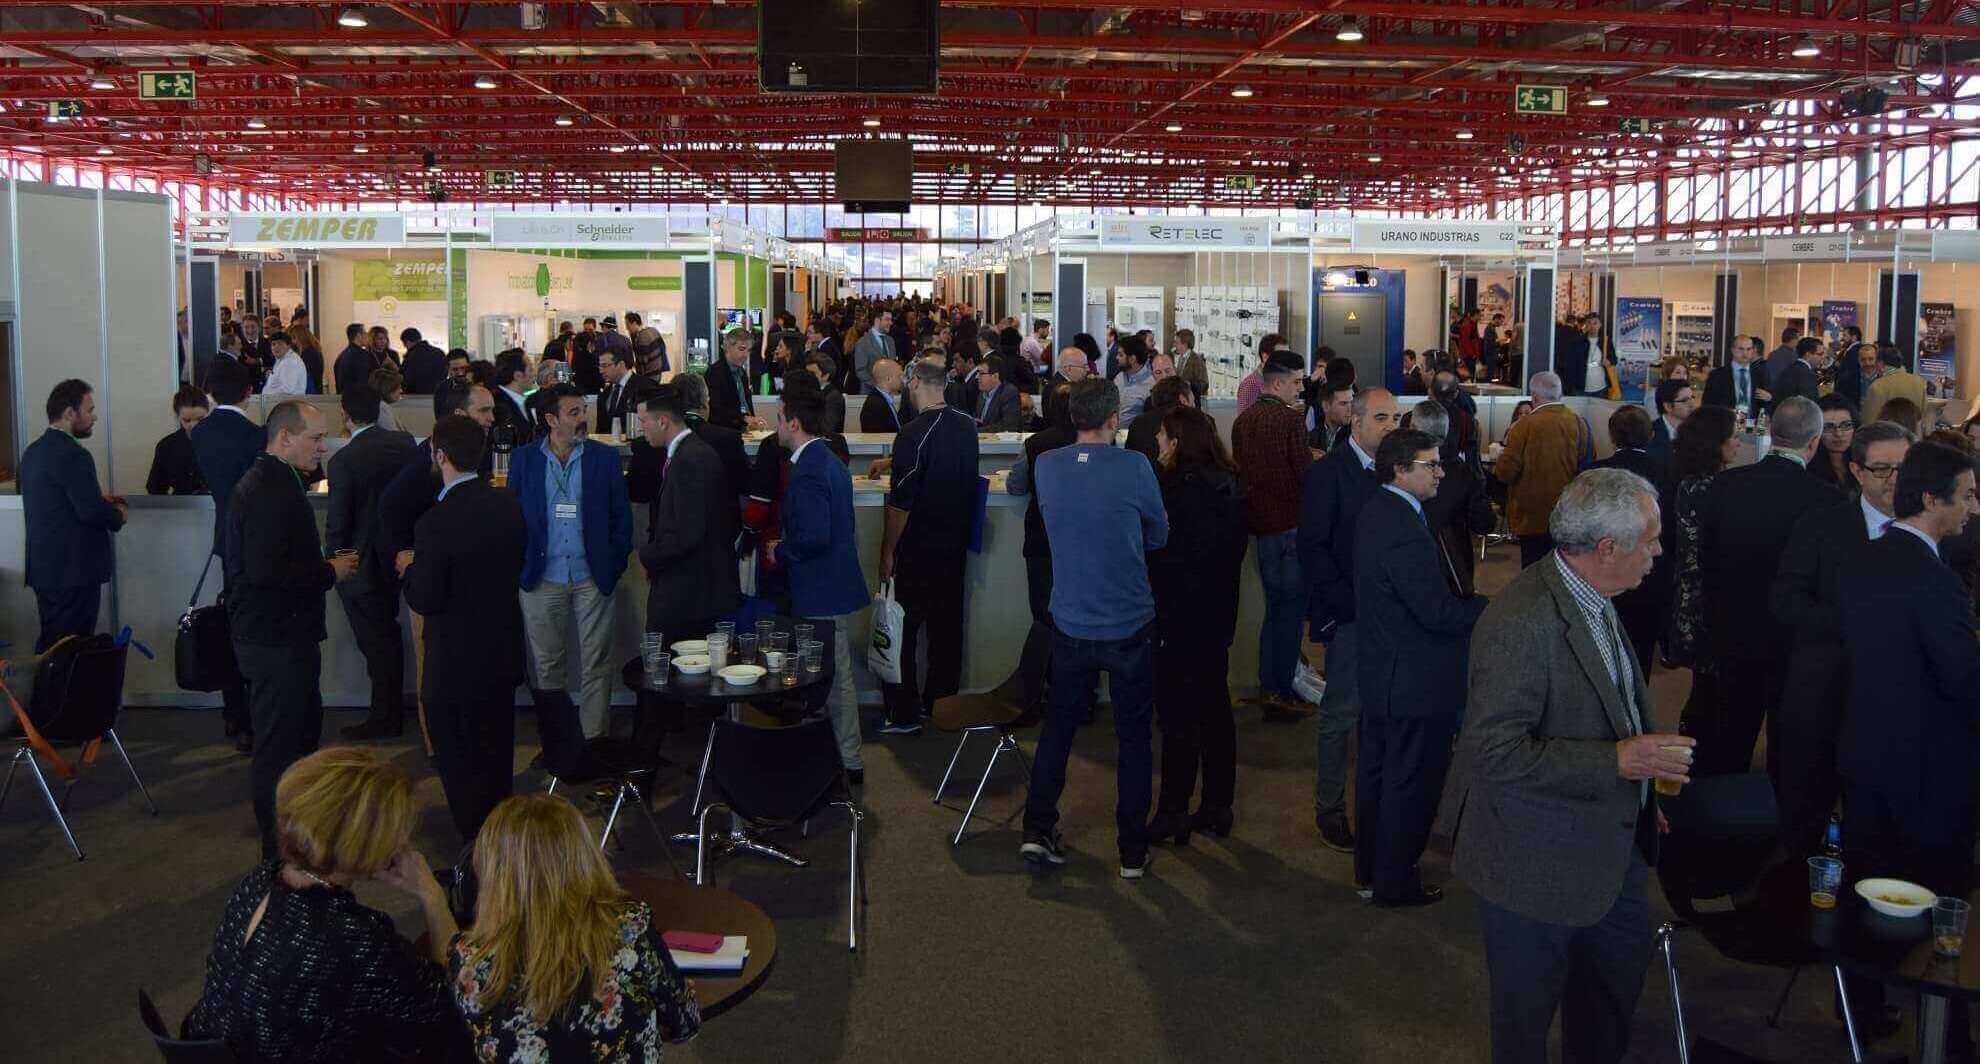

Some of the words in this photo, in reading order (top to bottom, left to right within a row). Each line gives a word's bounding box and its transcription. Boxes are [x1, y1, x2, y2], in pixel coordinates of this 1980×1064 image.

[256, 217, 378, 241] ZEMPER
[576, 223, 634, 237] Schneider
[1149, 225, 1223, 240] RETELEC
[1381, 231, 1417, 241] URANO
[1420, 231, 1480, 243] INDUSTRIAS
[392, 262, 448, 275] ZEMPE
